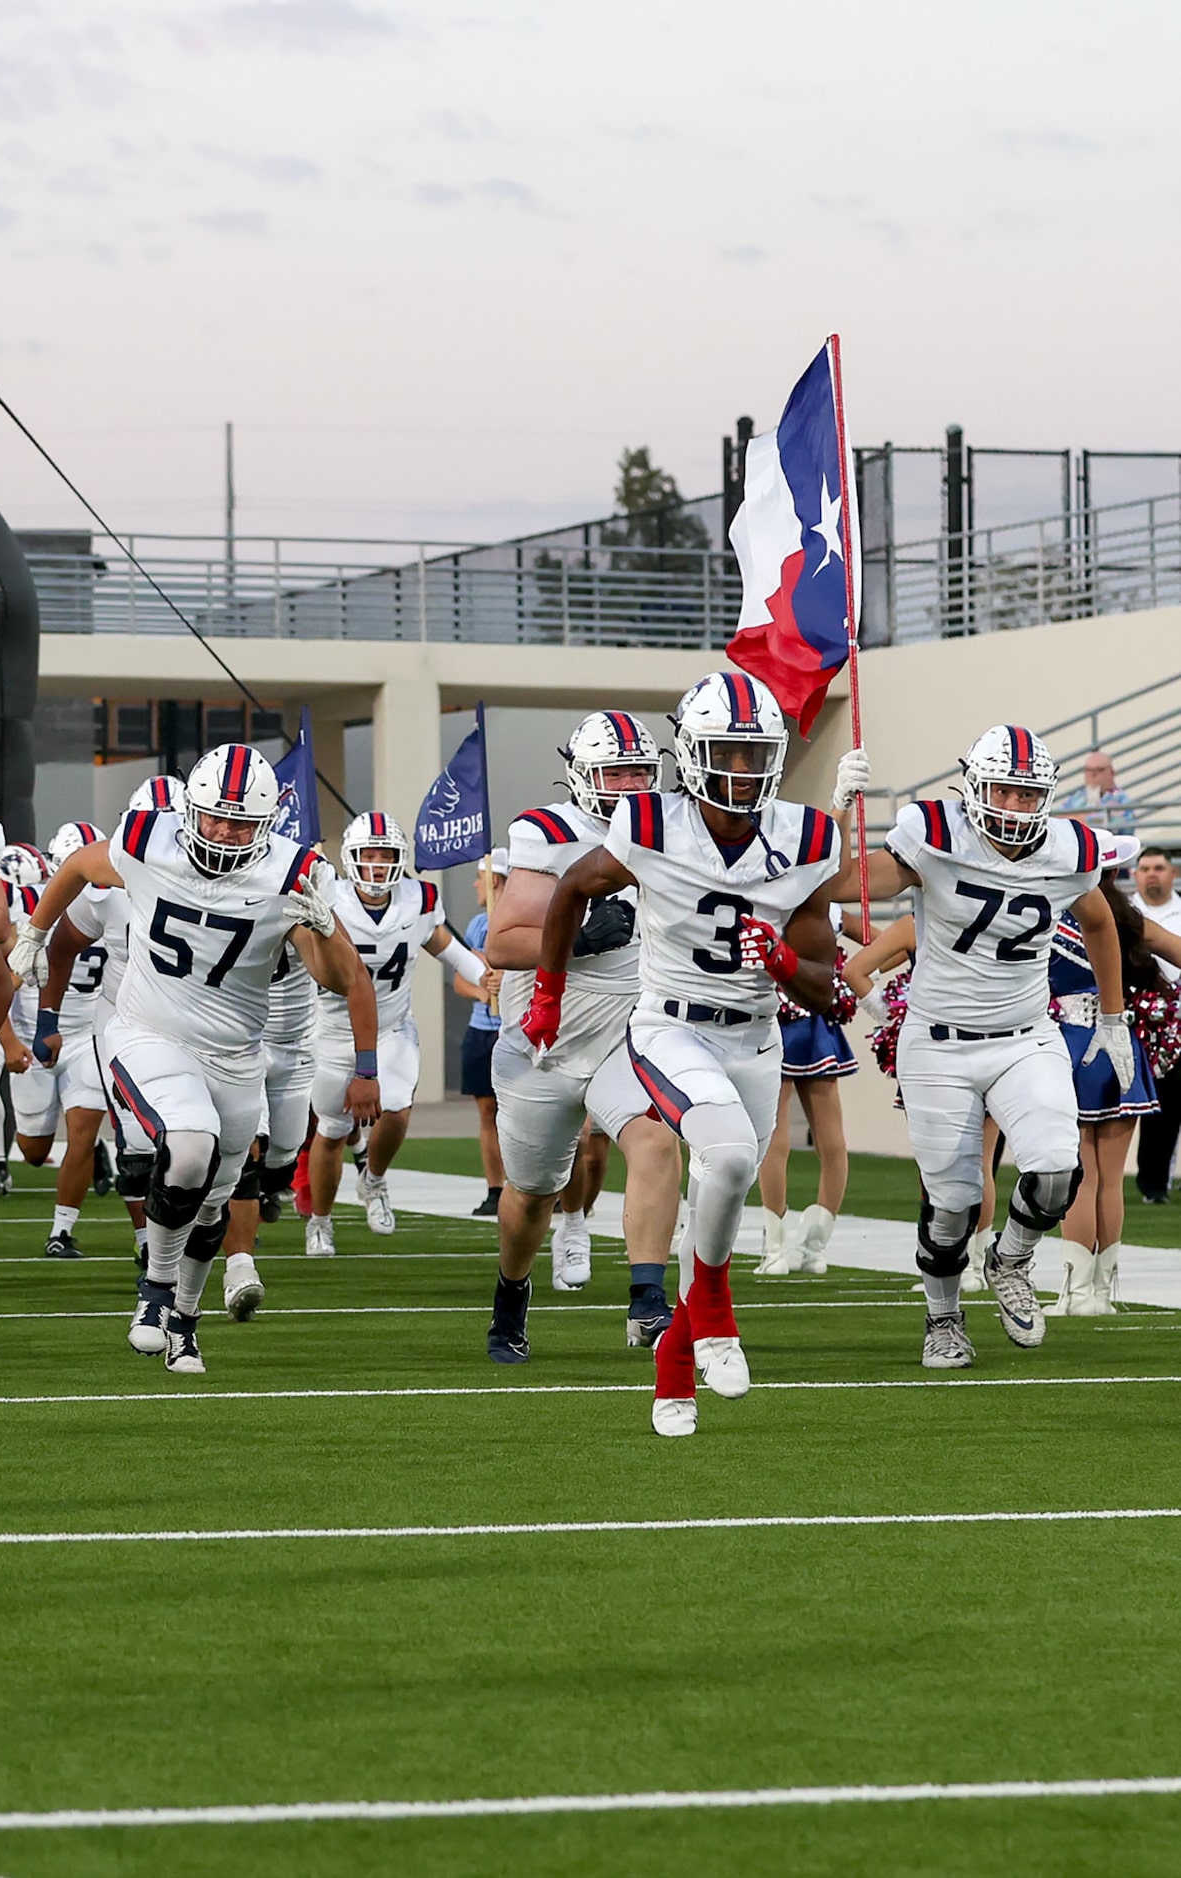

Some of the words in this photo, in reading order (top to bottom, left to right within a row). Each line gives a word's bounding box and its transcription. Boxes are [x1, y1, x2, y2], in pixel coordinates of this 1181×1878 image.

[149, 897, 254, 989] 57
[692, 891, 755, 974] 3
[951, 880, 1052, 962] 72
